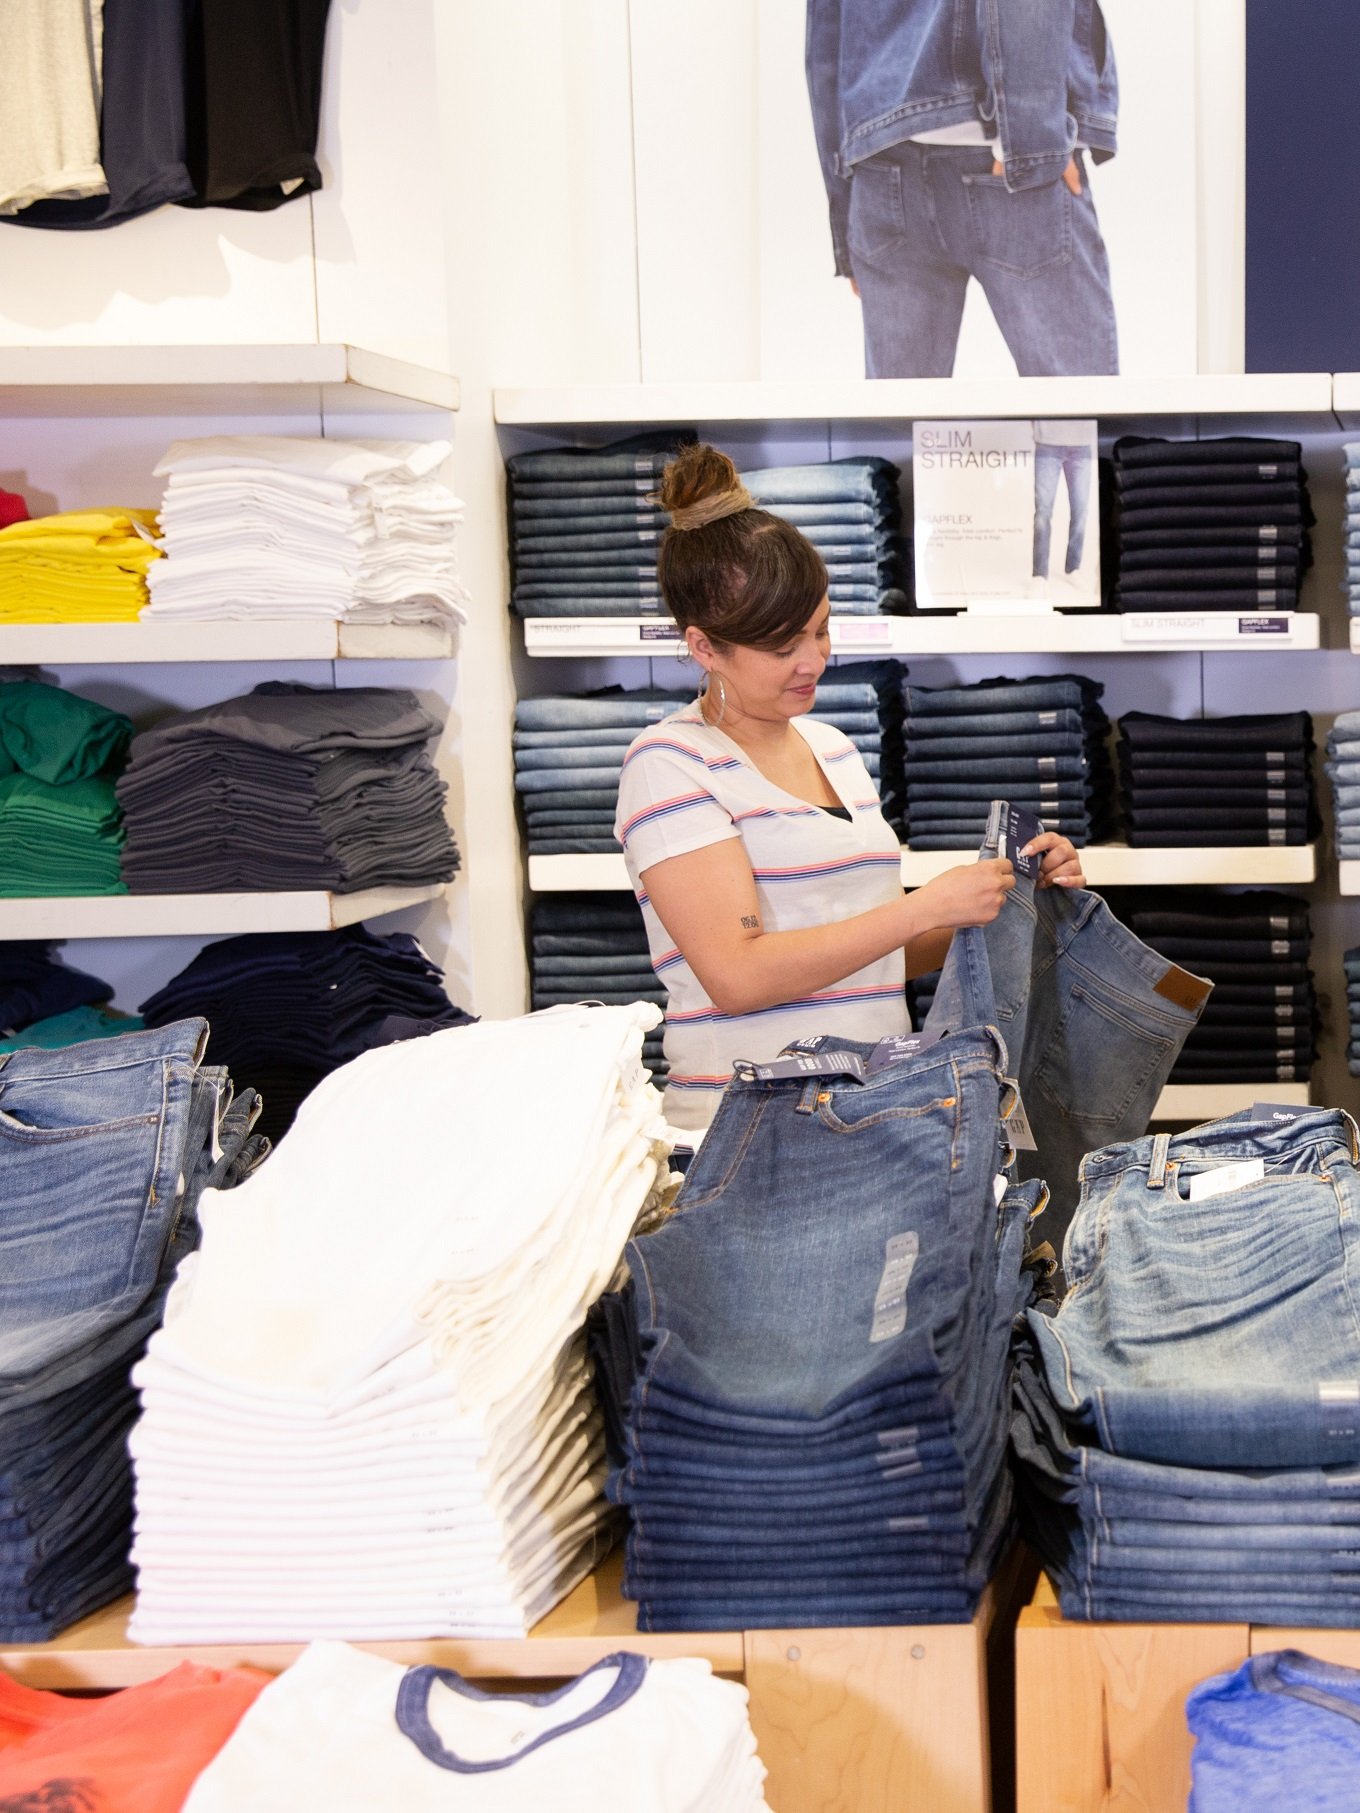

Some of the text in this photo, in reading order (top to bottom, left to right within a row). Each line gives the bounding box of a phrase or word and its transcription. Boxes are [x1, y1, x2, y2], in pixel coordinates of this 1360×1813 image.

[921, 430, 973, 448] SLIM
[921, 450, 1032, 469] STRAIGHT
[1010, 1119, 1025, 1135] GAP
